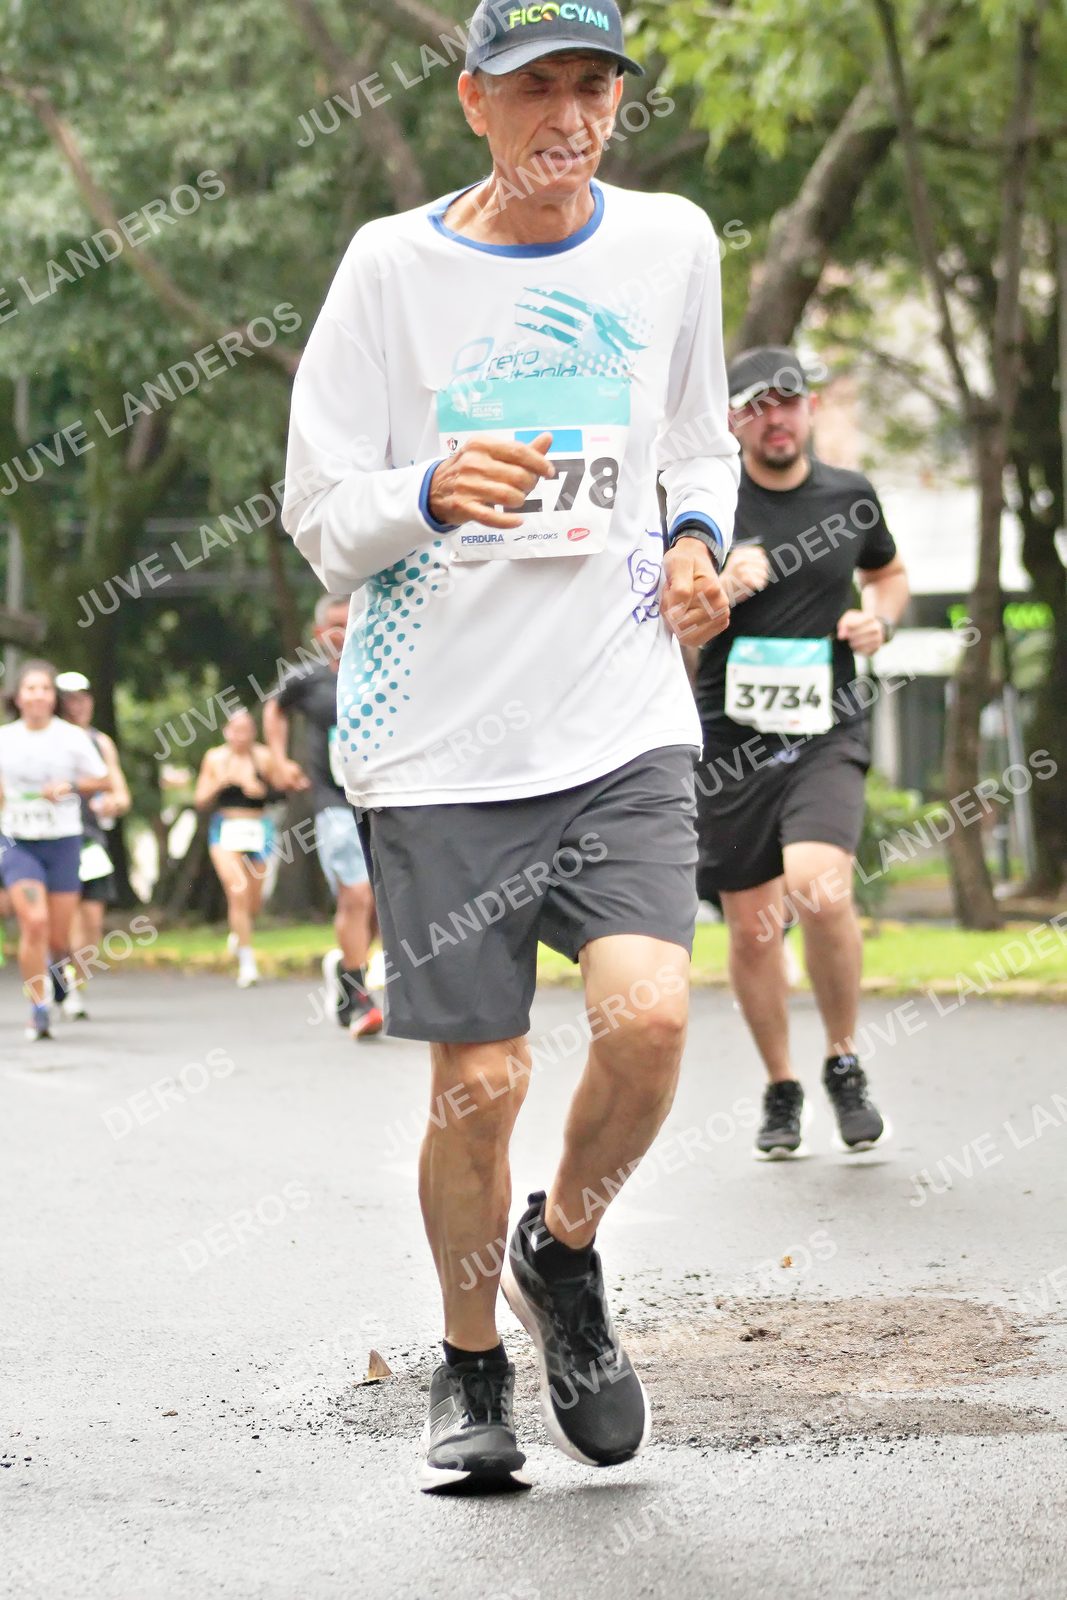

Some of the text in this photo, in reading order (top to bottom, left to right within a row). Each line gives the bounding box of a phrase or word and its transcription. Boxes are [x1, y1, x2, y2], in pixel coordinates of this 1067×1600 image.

[485, 457, 619, 513] 278
[461, 534, 504, 544] PERDURA
[527, 533, 559, 541] BROOKS
[736, 684, 821, 711] 3734
